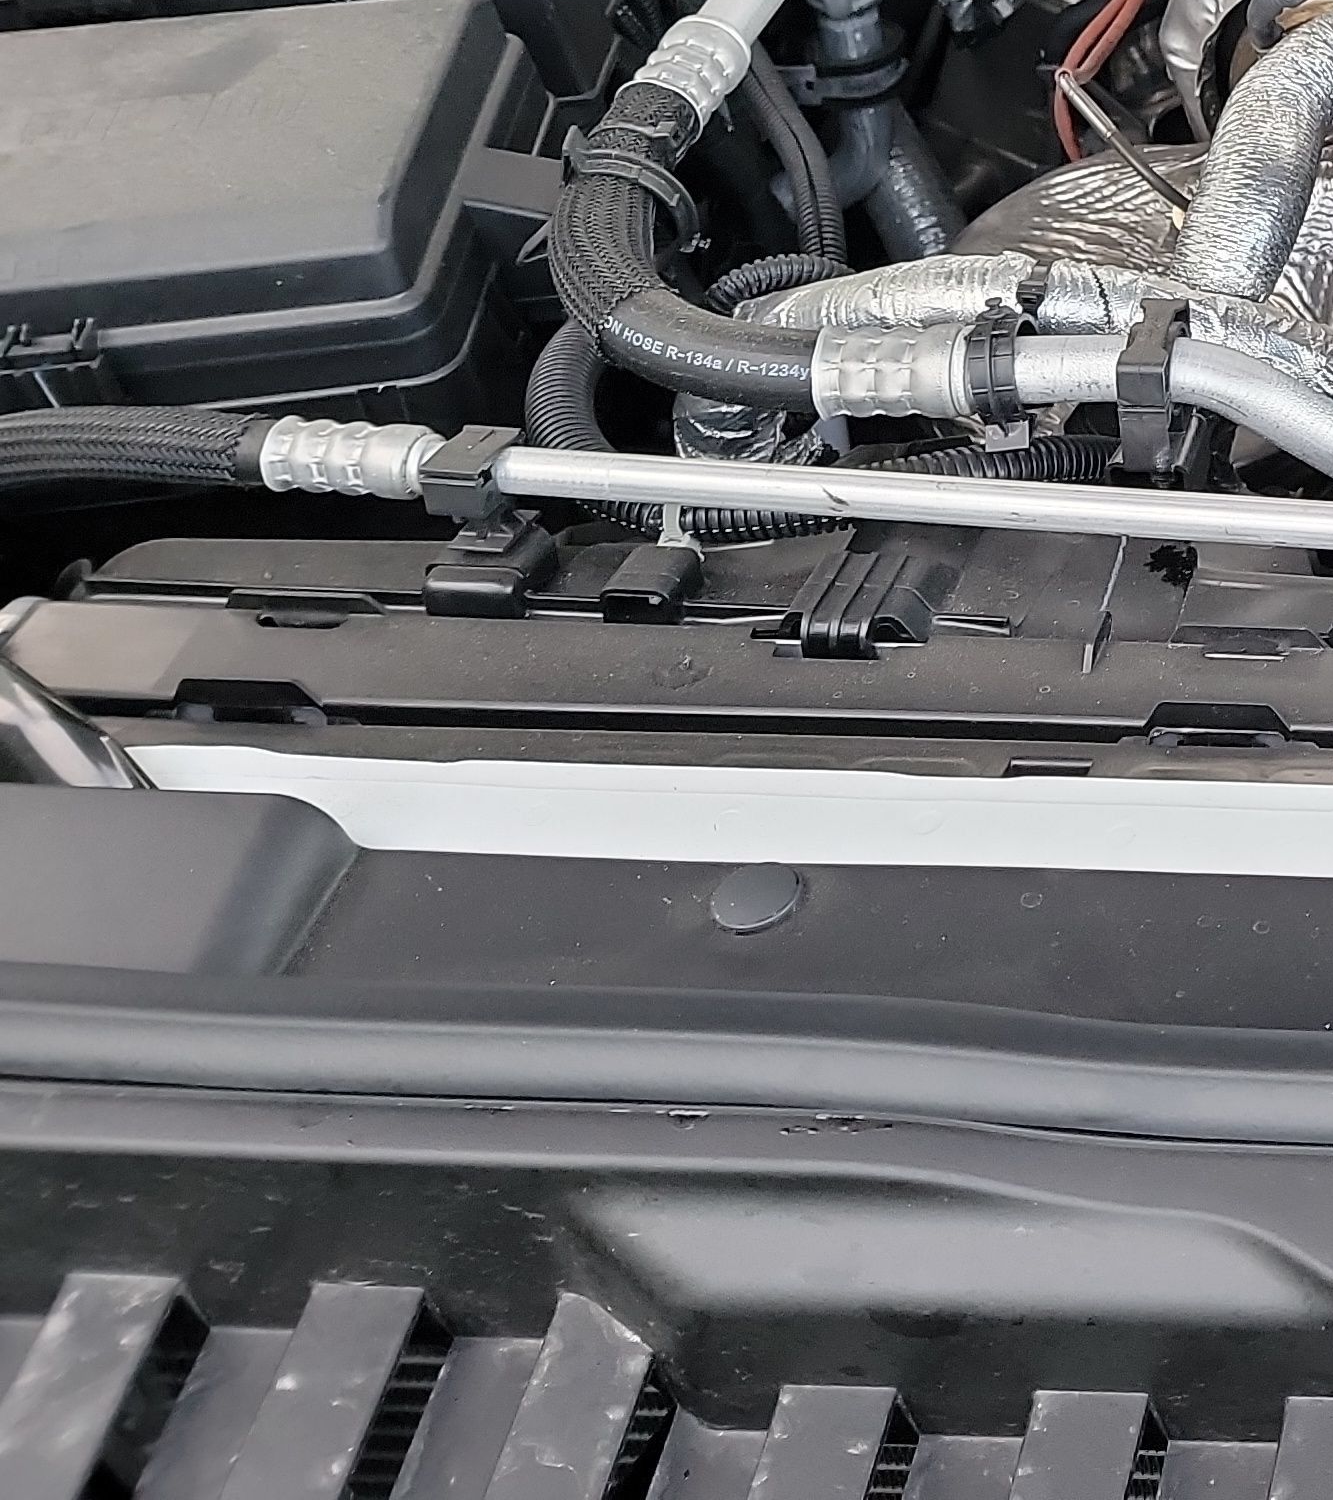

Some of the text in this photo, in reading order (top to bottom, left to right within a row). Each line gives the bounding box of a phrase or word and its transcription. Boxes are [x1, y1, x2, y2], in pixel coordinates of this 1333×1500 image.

[622, 327, 664, 356] HOSE
[665, 345, 722, 370] R-134a
[737, 360, 810, 380] R-1234y
